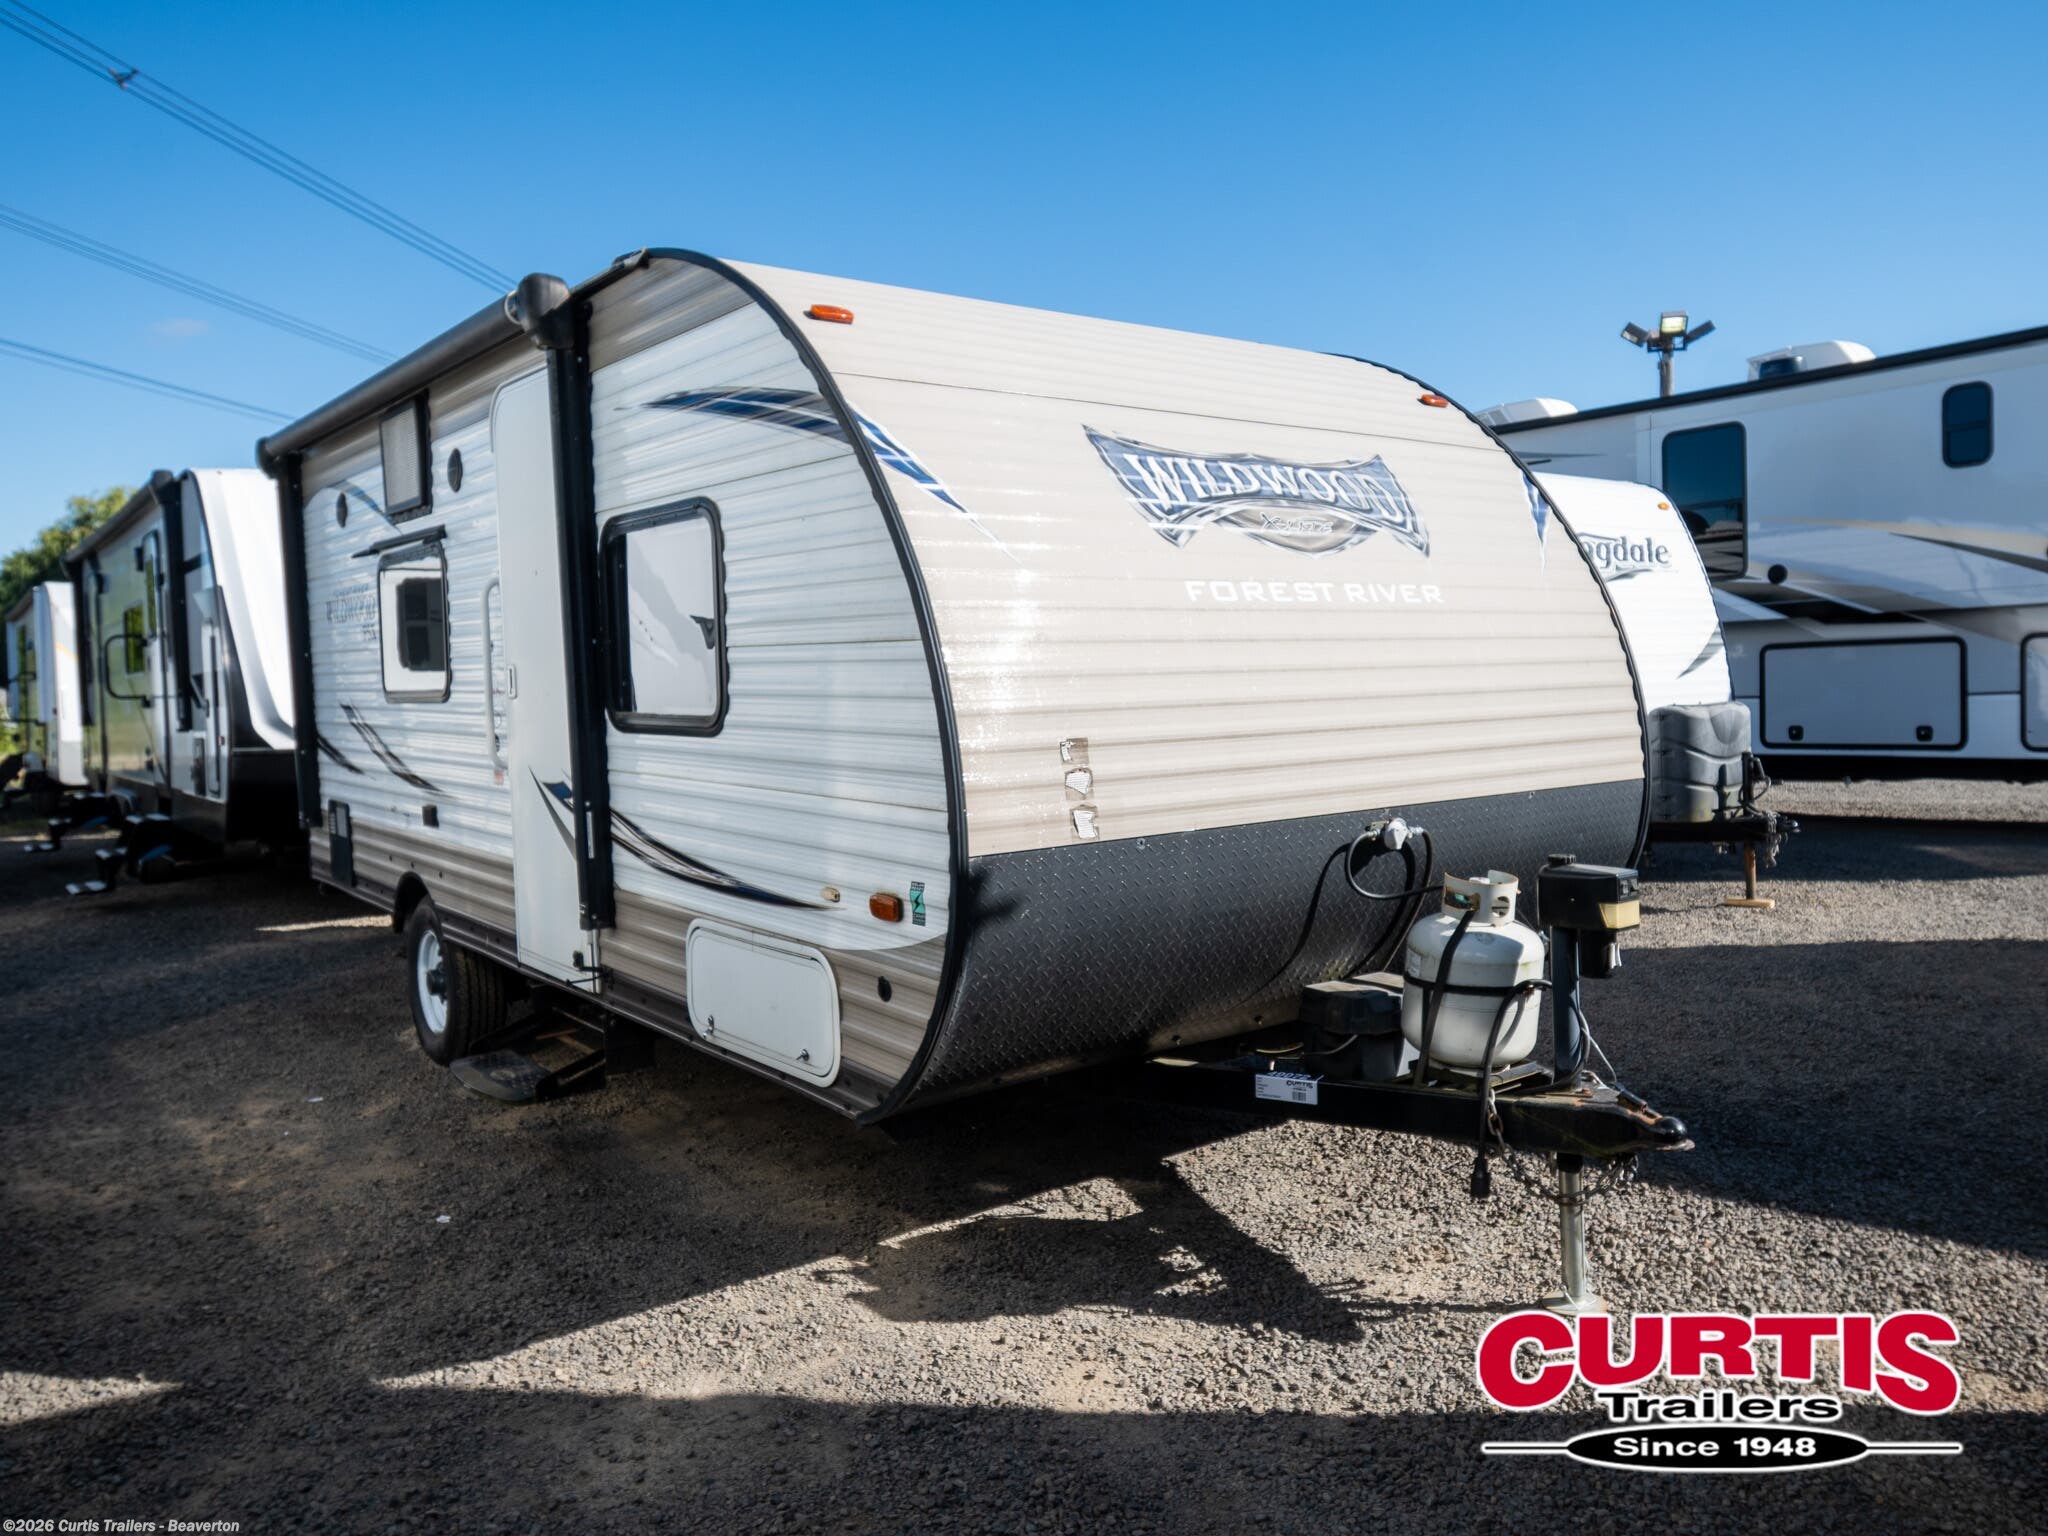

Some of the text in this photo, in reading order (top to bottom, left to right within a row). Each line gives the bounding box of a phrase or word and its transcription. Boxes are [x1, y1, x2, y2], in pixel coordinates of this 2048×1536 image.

[1122, 454, 1404, 522] WILDWOOD
[1184, 580, 1445, 603] FOREST RIVER
